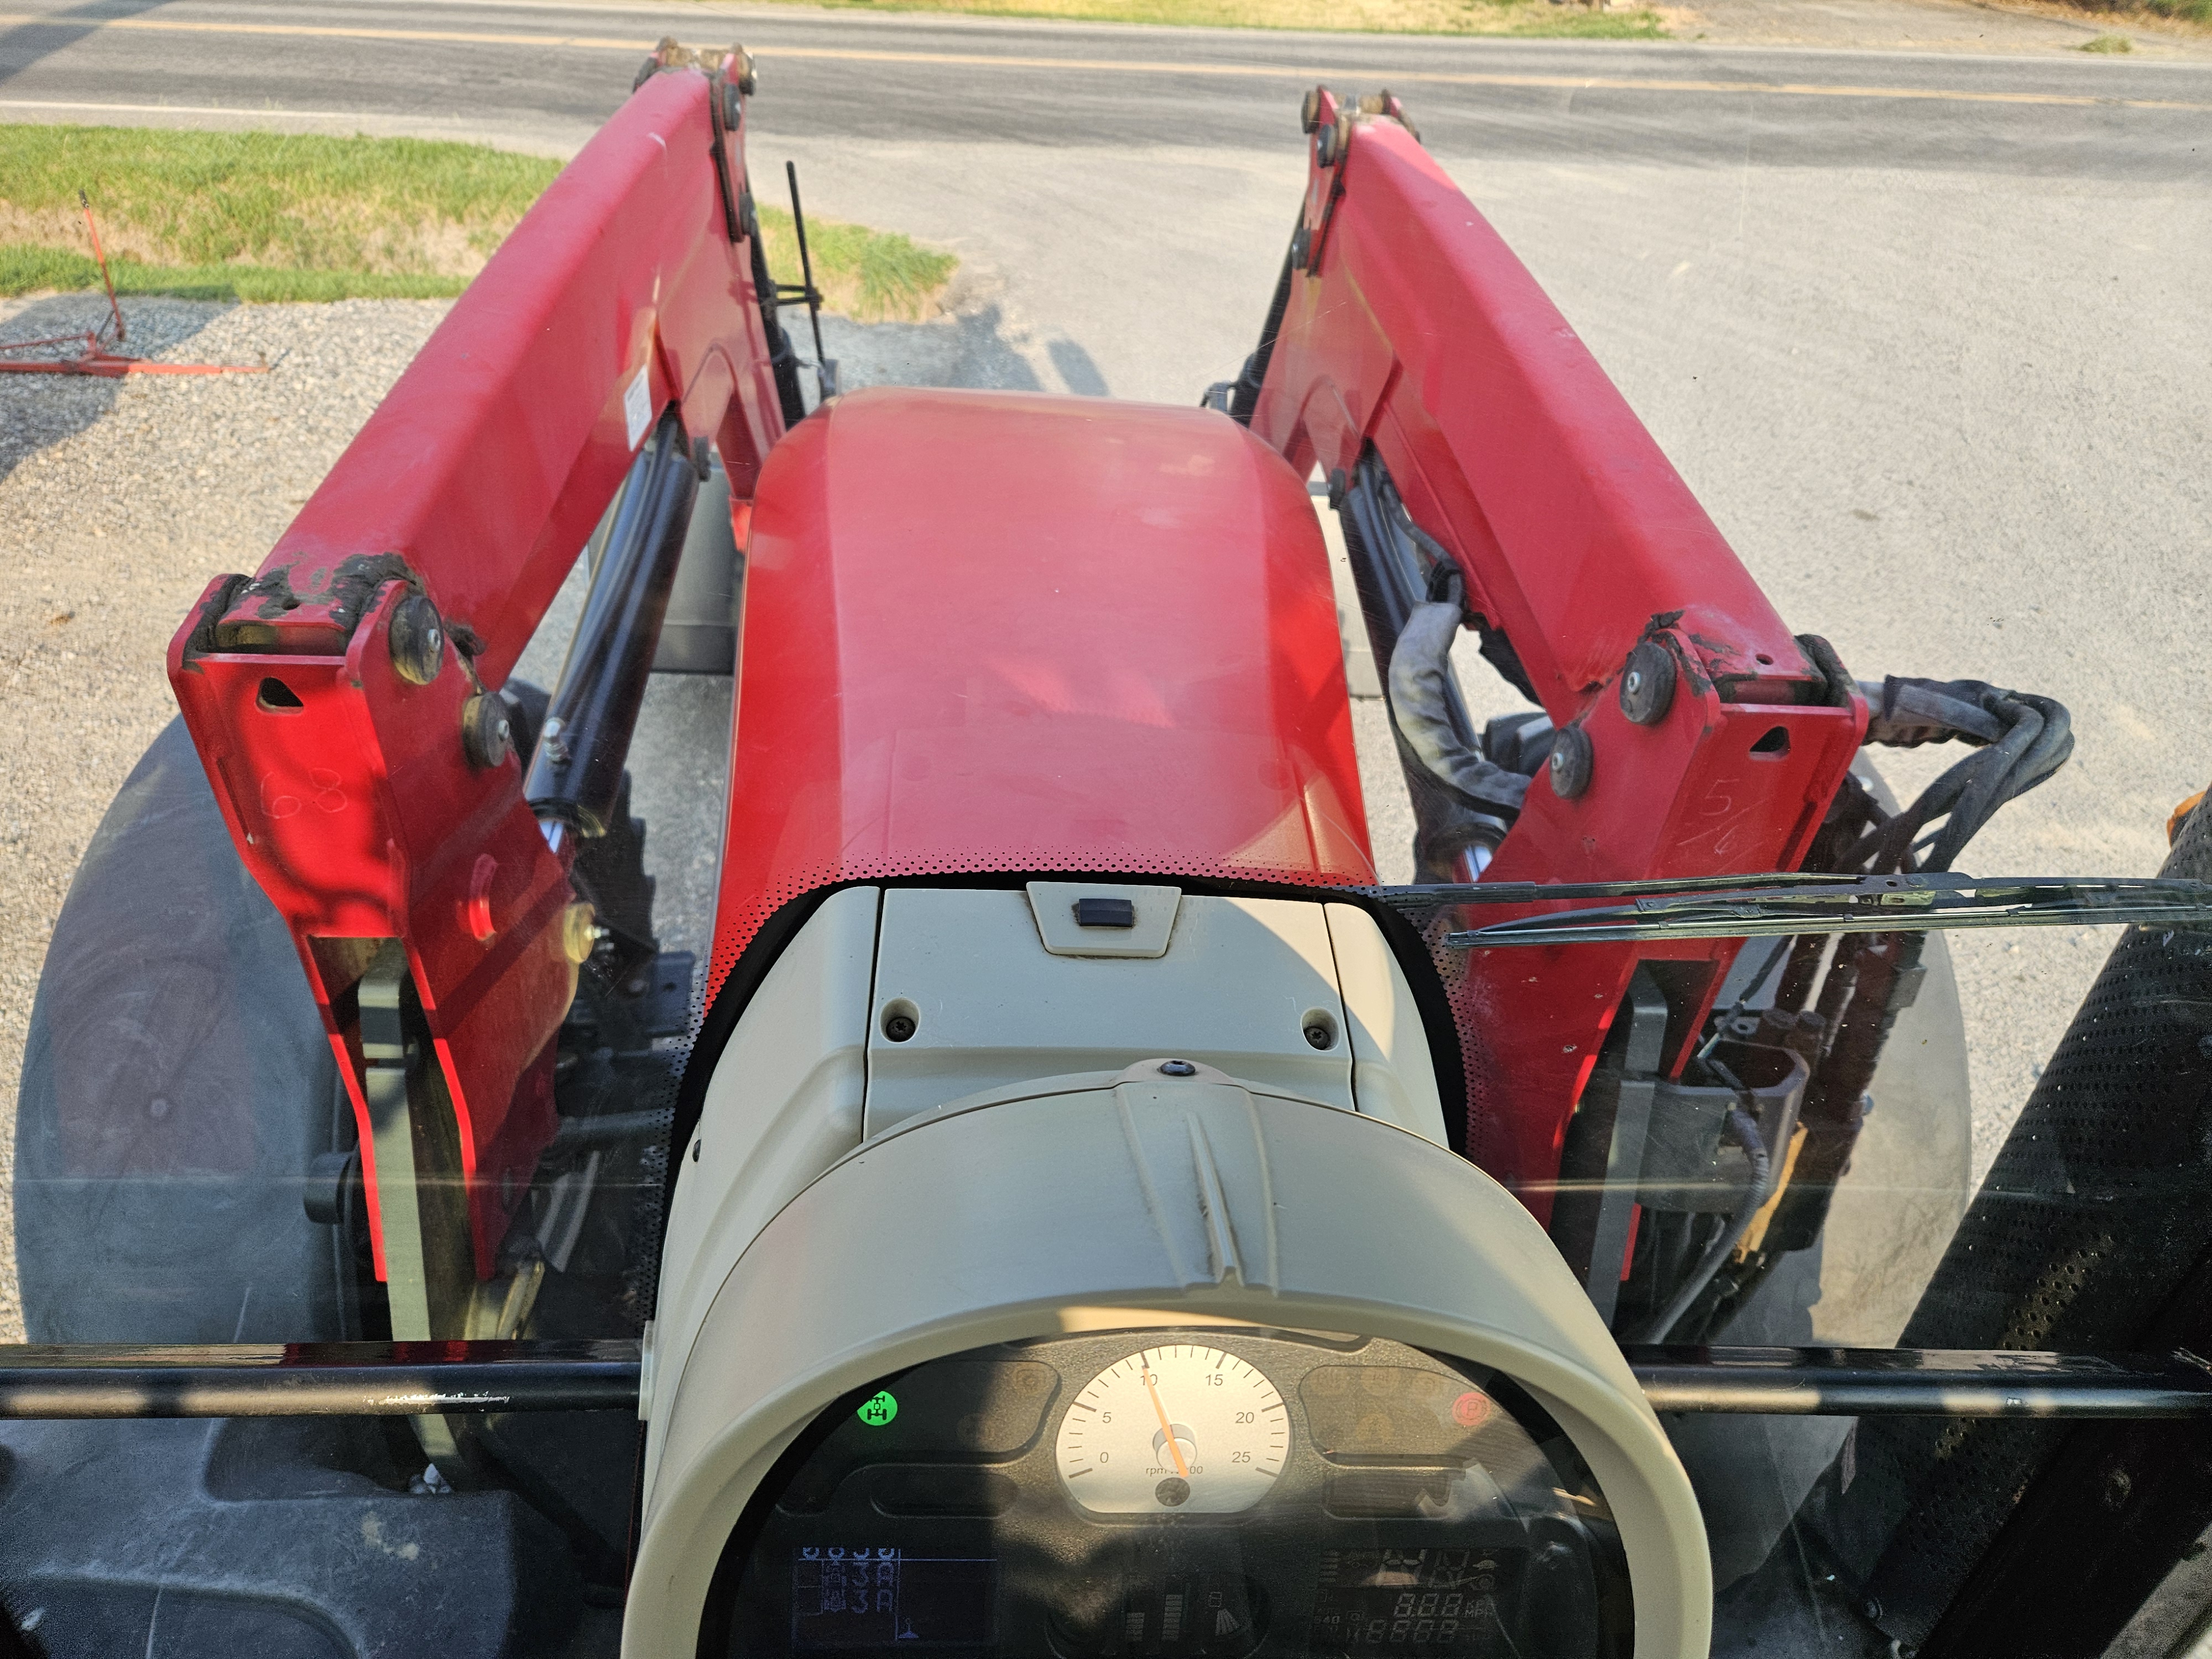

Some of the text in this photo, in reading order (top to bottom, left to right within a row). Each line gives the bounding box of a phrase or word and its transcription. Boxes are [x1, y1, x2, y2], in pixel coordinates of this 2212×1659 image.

[260, 767, 348, 820] 68
[1139, 1373, 1159, 1386] 10
[1205, 1373, 1224, 1386] 15
[1102, 1411, 1112, 1424] 5
[1235, 1411, 1255, 1424] 20
[1099, 1452, 1109, 1464] 0
[1231, 1451, 1251, 1463] 25
[1145, 1468, 1167, 1477] rpm
